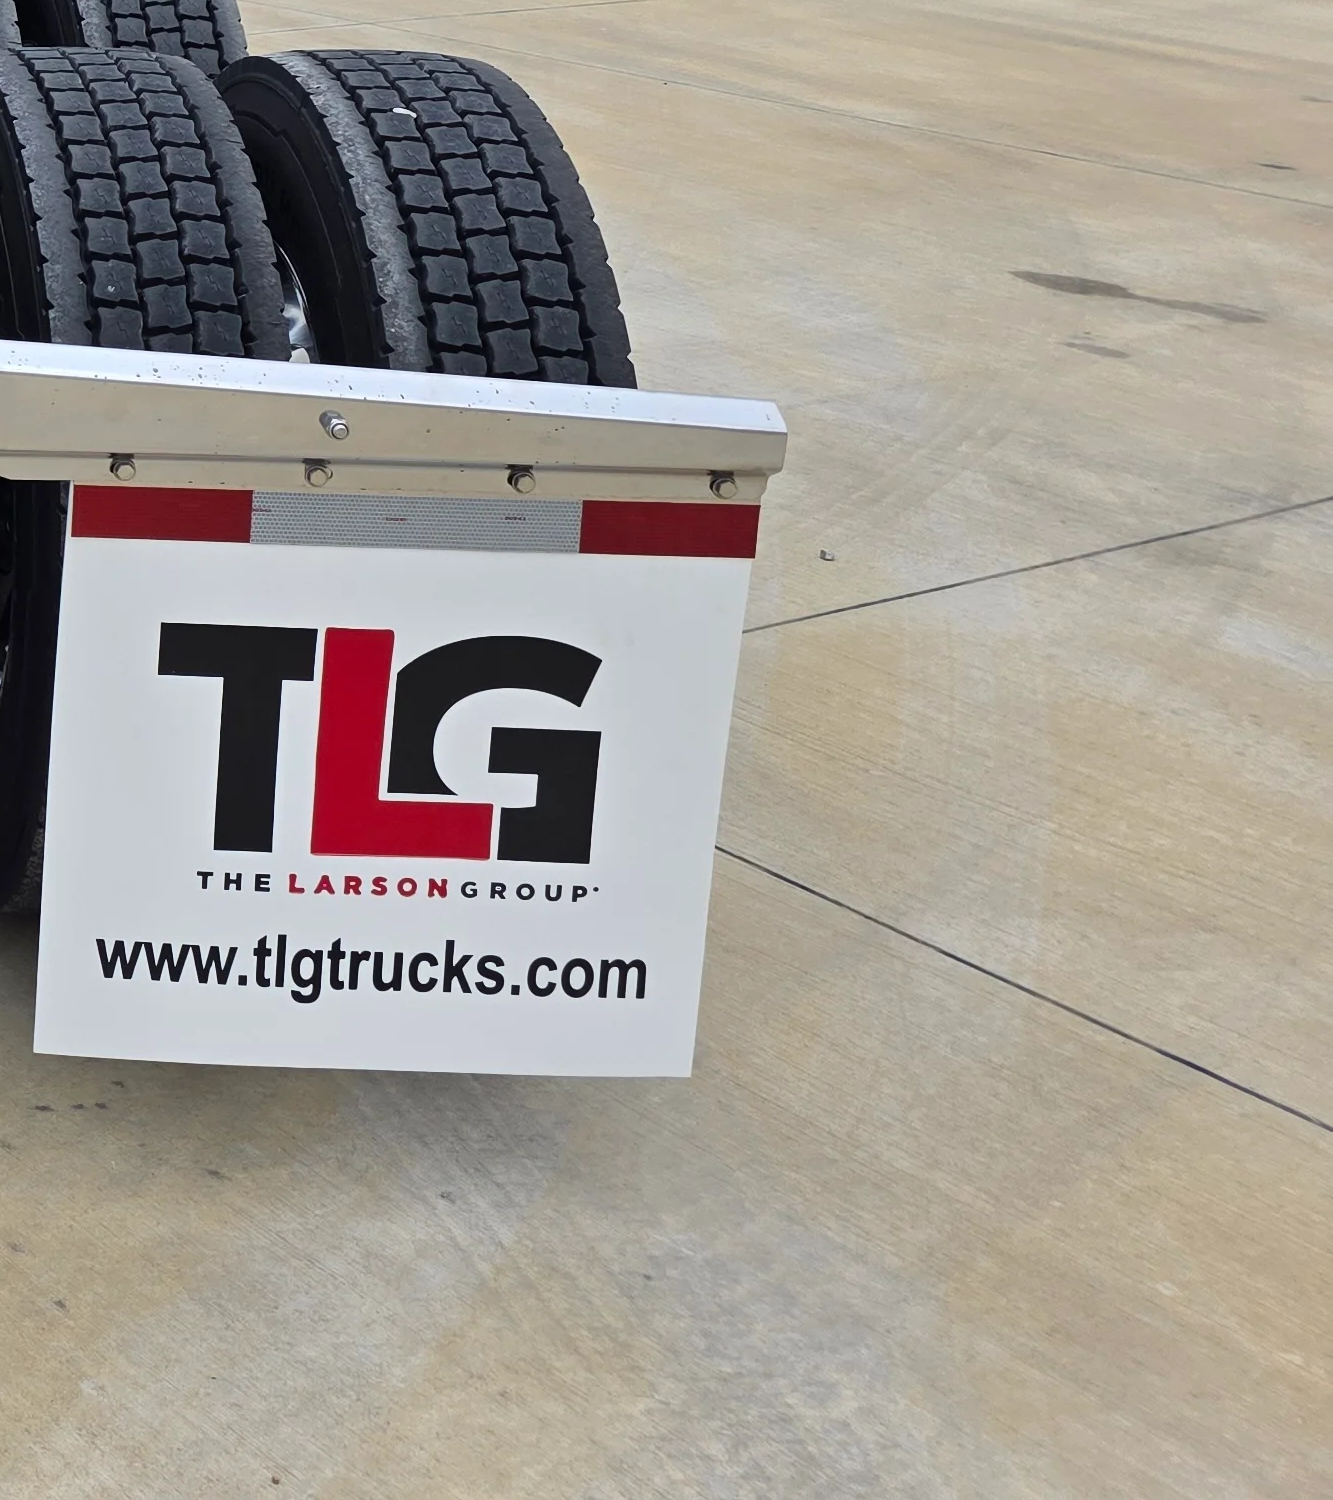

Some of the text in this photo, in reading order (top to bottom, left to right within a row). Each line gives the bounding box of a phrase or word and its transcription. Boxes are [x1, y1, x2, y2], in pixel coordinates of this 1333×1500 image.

[157, 622, 603, 865] TLG
[196, 870, 590, 903] THE LARSON GROUP
[95, 932, 648, 1004] www.tlgtrucks.com
